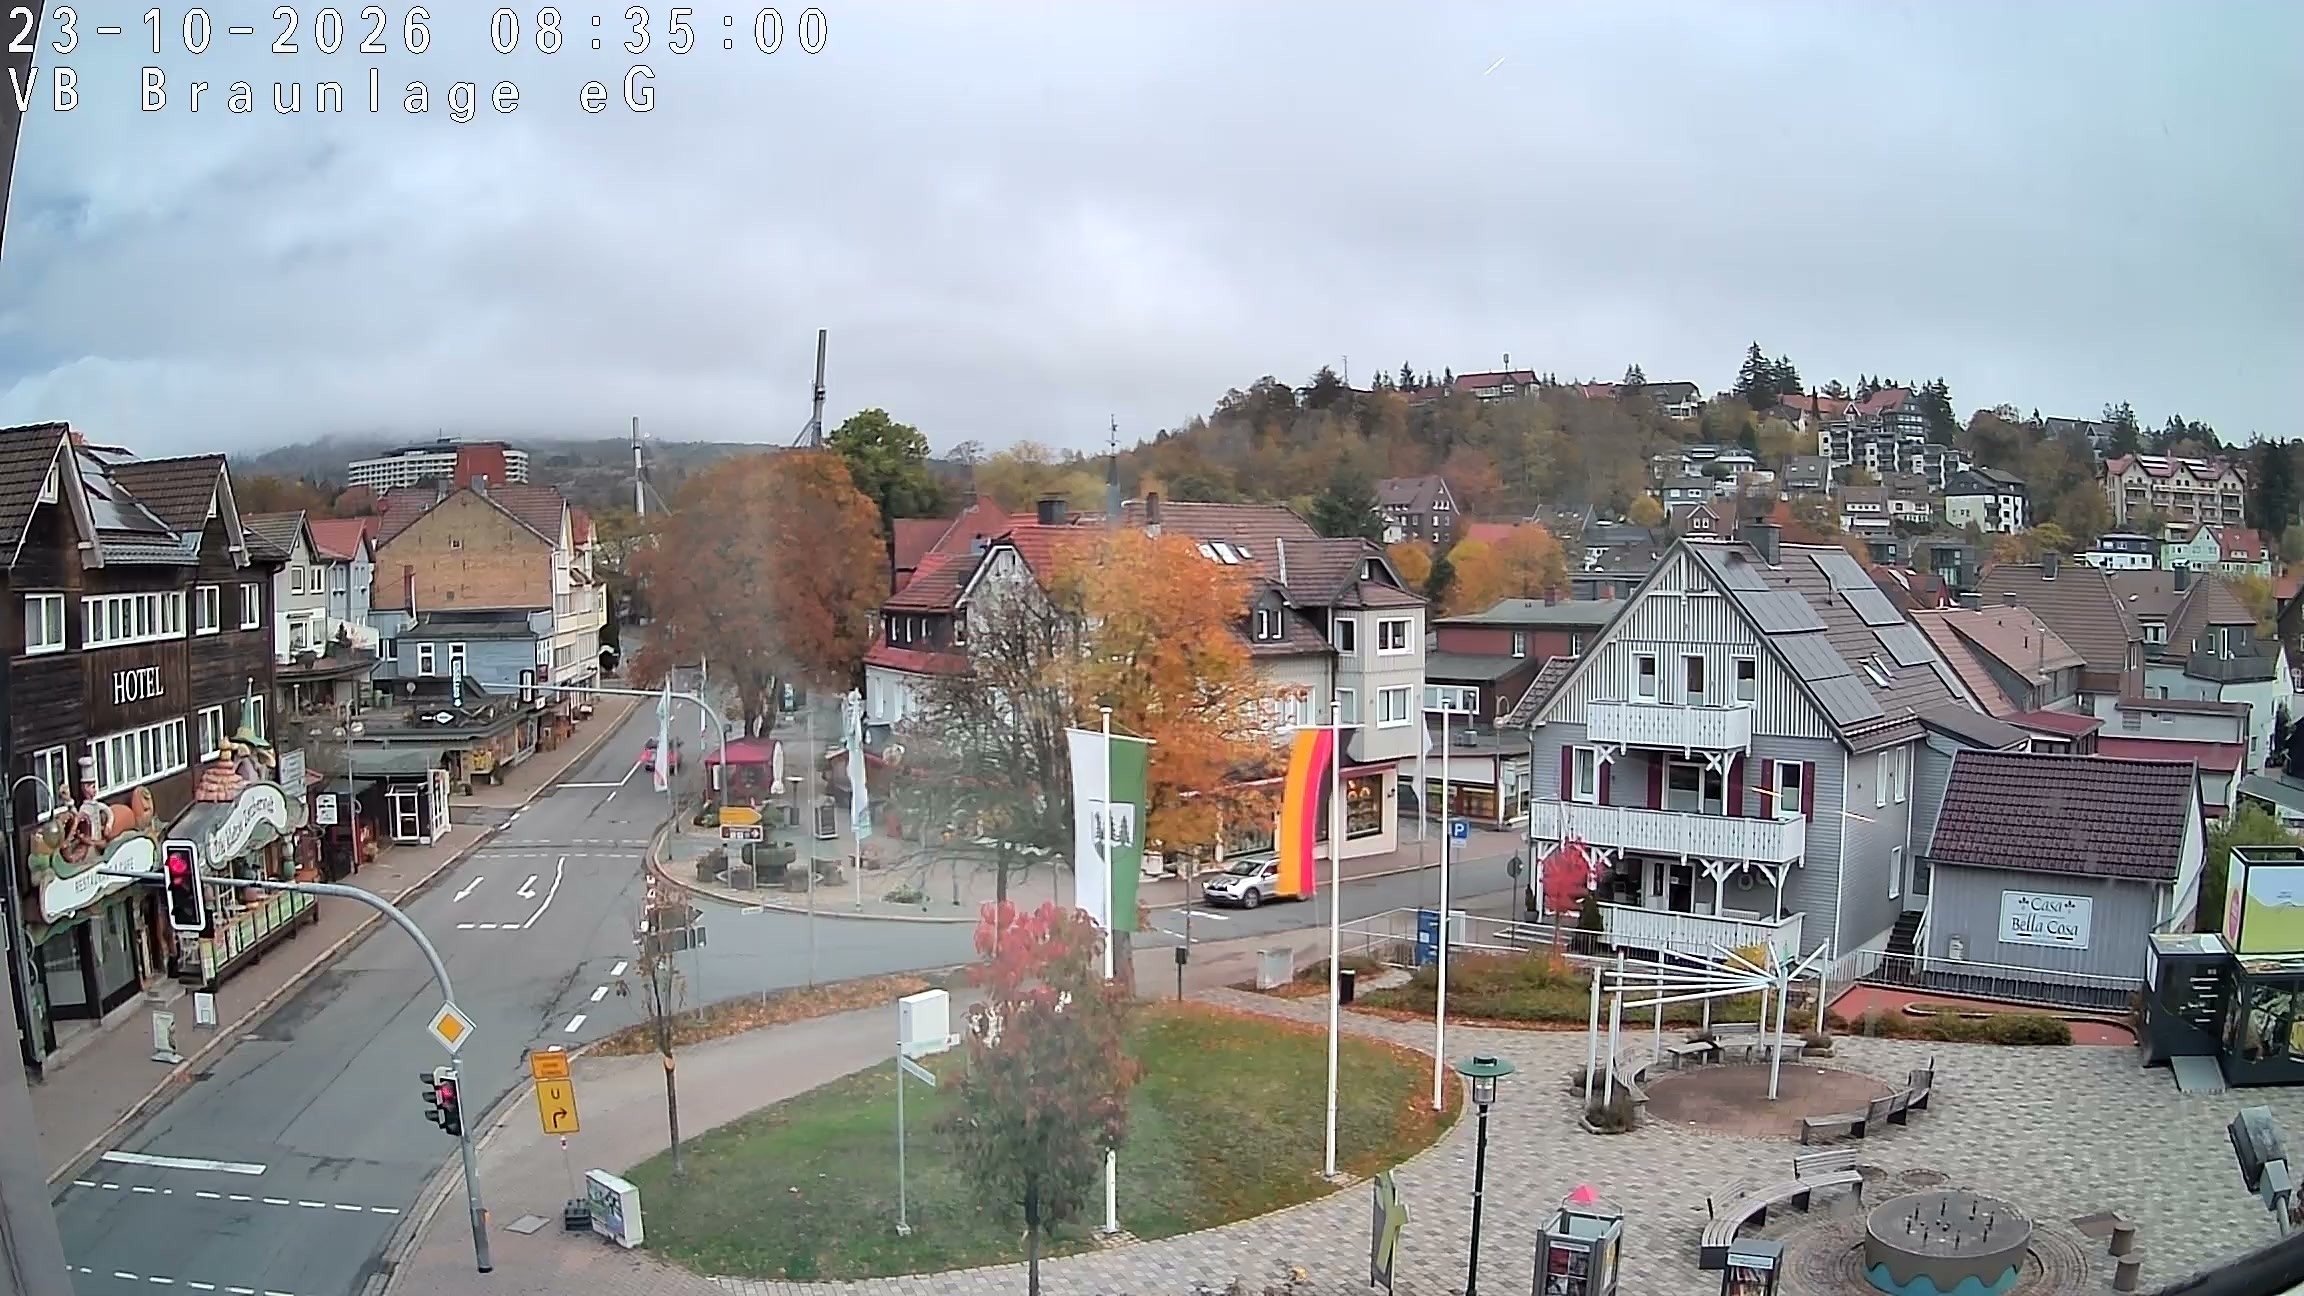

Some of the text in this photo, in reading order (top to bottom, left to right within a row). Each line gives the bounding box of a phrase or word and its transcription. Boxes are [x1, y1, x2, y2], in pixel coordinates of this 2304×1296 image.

[112, 665, 165, 705] HOTEL
[1454, 823, 1465, 837] P
[2031, 897, 2062, 912] Casa
[2012, 914, 2043, 932] Bella
[550, 1087, 561, 1100] U
